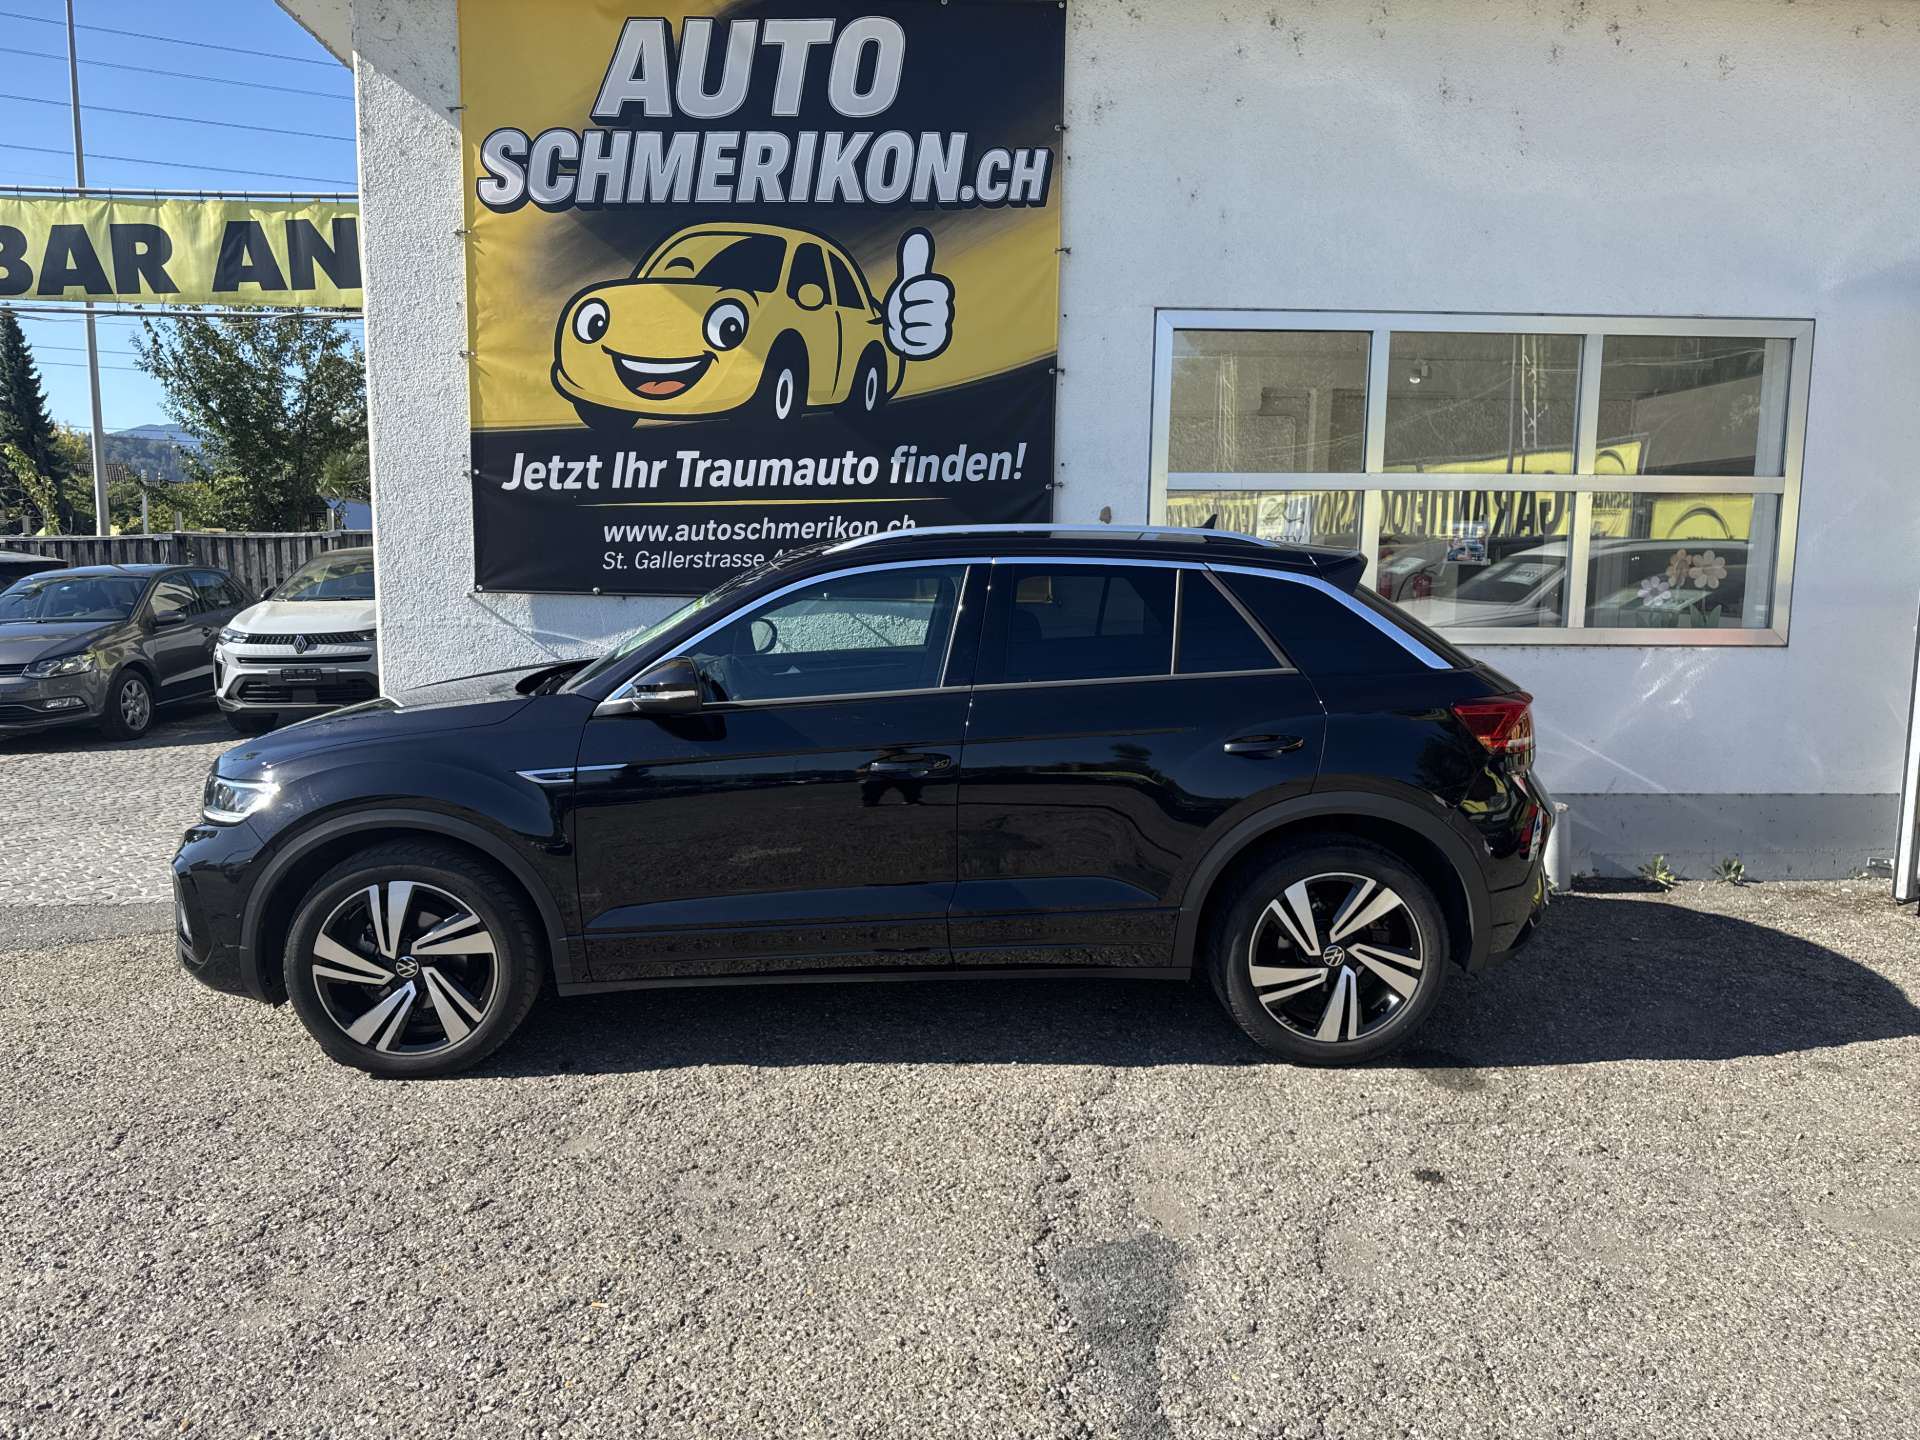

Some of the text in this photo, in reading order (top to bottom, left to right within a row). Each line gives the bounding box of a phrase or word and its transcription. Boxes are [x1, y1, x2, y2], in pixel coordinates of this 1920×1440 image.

[591, 15, 907, 122] AUTO
[476, 129, 1052, 209] SCHMERIKON.CH
[502, 442, 1027, 491] Jetzt Ihr Traumauto finden!
[603, 514, 916, 543] www.autoschmerikonch
[602, 551, 627, 570] St.
[634, 549, 765, 569] Gallerstrasse
